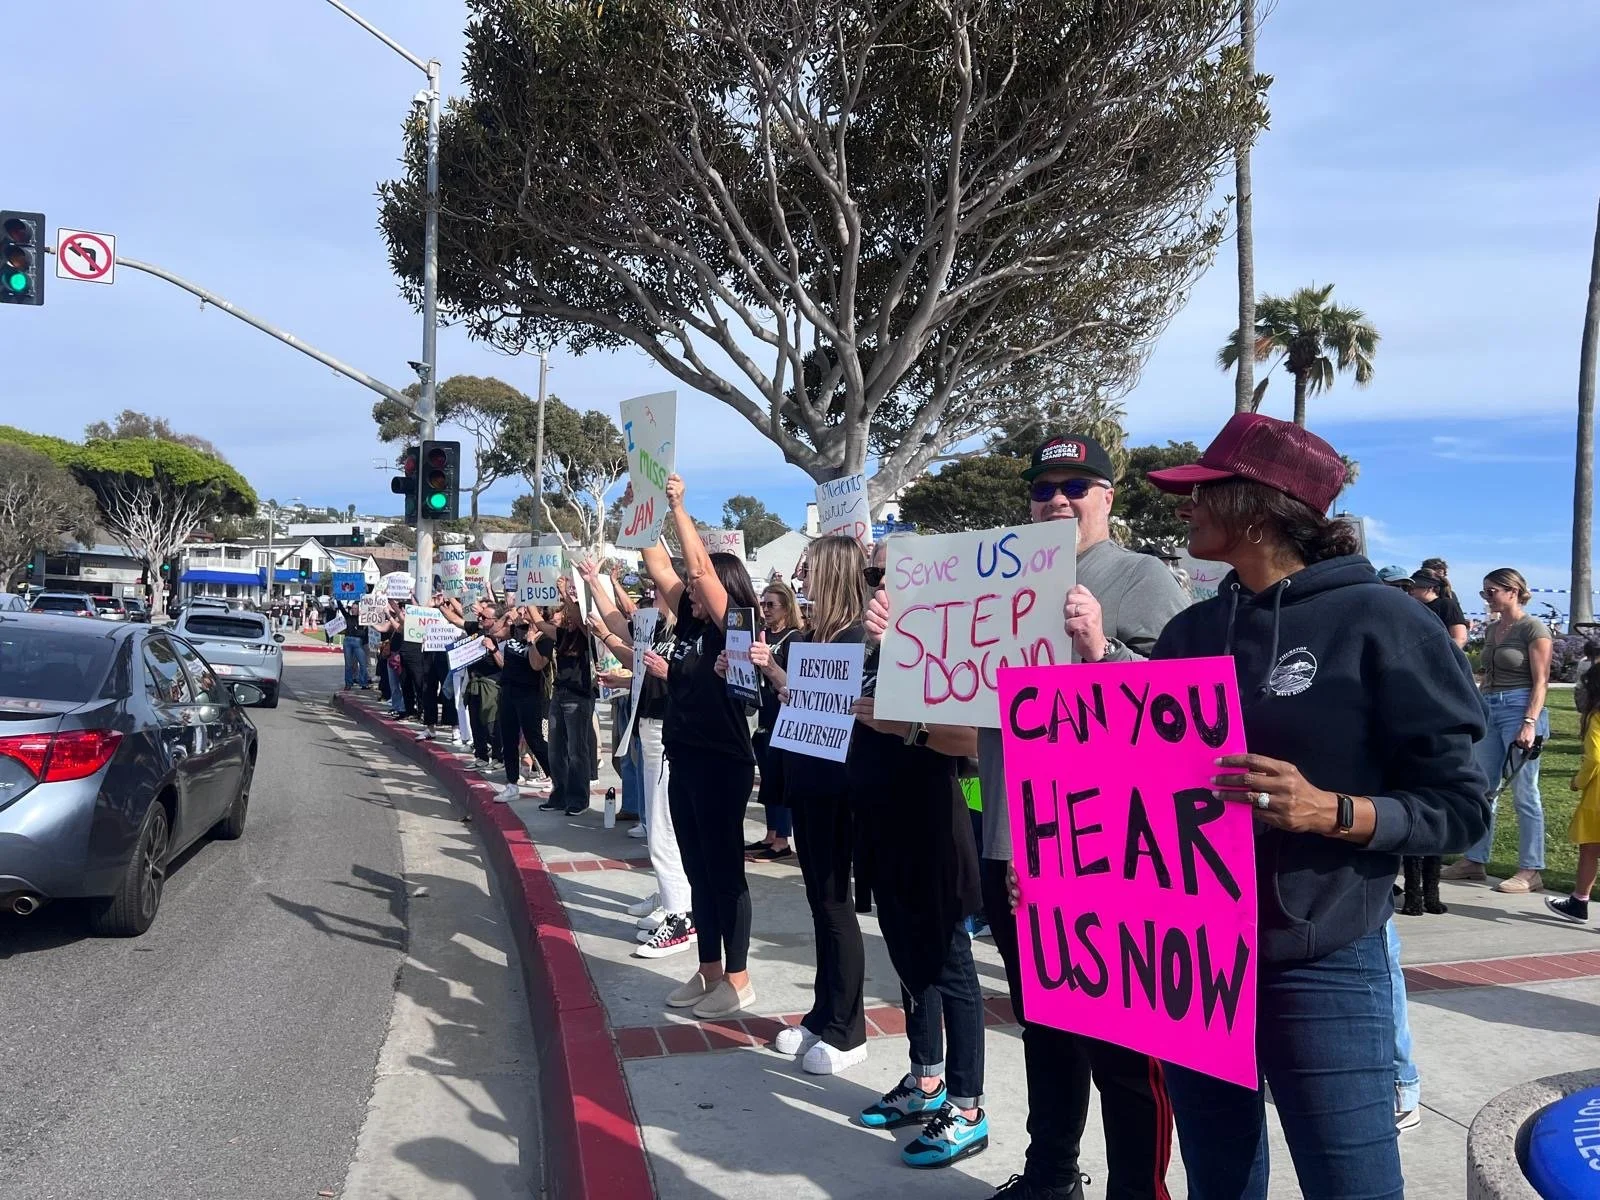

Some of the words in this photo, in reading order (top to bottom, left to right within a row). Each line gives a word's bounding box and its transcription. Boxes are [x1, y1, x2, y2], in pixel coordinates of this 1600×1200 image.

[624, 420, 635, 452] I
[639, 447, 667, 490] MISS
[624, 496, 654, 536] JAN
[522, 553, 534, 568] WE
[538, 554, 560, 567] ARE
[527, 571, 544, 583] ALL
[895, 588, 1037, 669] STEP
[799, 658, 850, 681] RESTORE
[786, 688, 855, 716] FUNCTIONAL
[1009, 682, 1109, 744] CAN
[1119, 681, 1230, 749] YOU
[777, 719, 848, 750] LEADERSHIP
[1022, 779, 1242, 902] HEAR
[1028, 902, 1109, 999] US
[1118, 919, 1251, 1037] NOW
